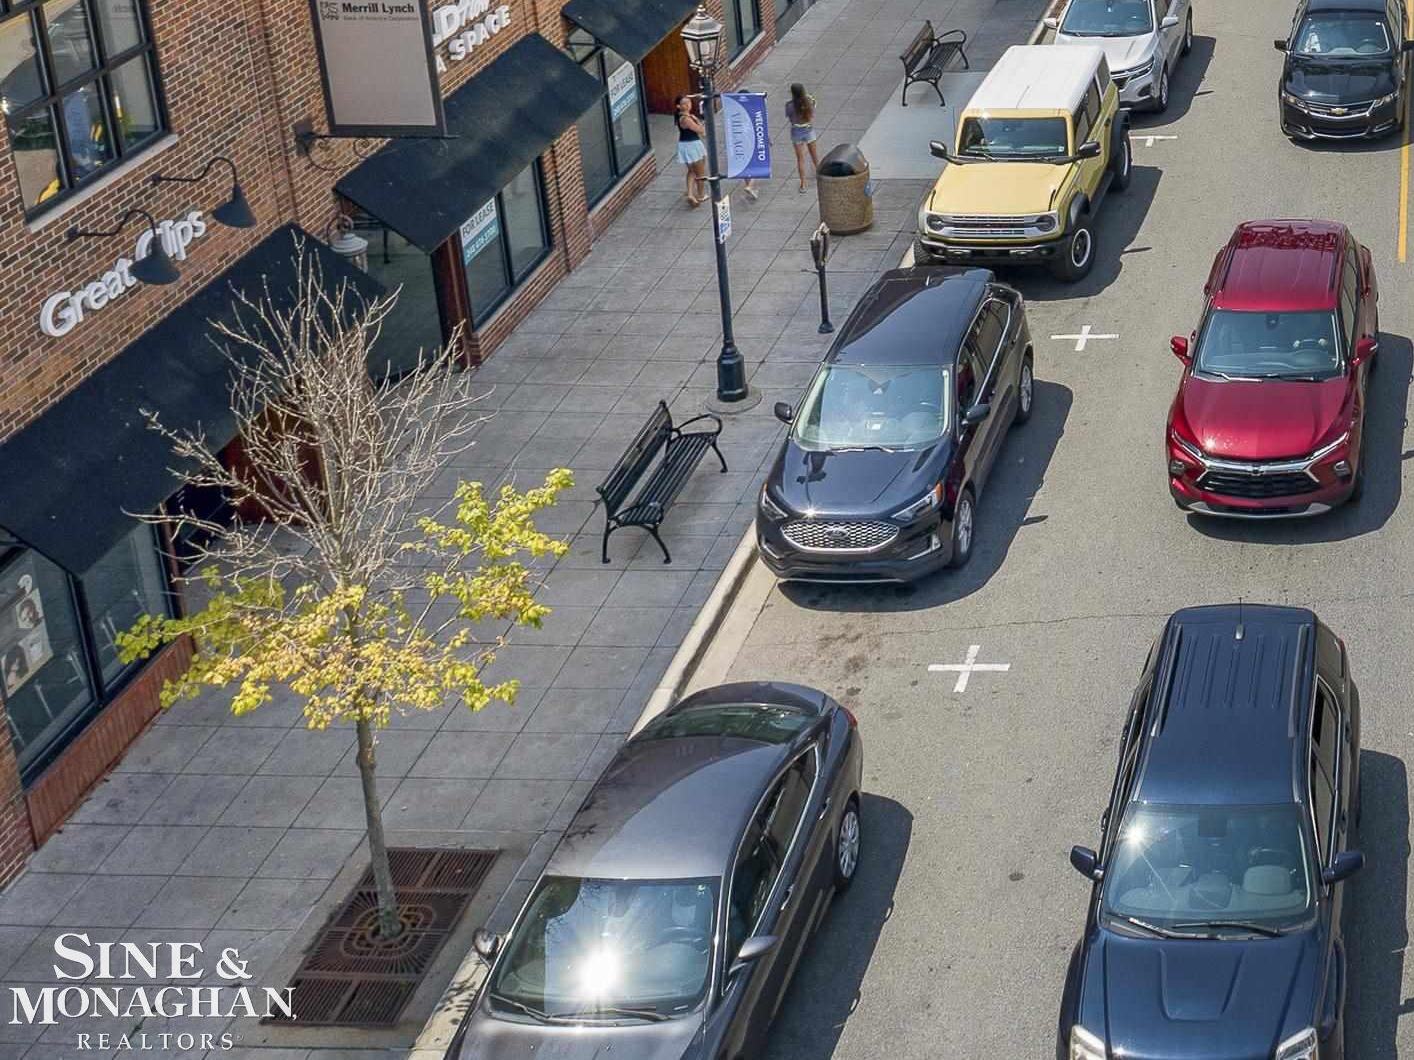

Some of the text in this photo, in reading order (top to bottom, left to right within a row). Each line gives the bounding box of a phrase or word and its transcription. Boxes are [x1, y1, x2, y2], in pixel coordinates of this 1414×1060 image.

[342, 3, 415, 16] Merrill Lynch
[448, 4, 512, 61] SPACE
[731, 112, 745, 161] VILLAGE
[754, 110, 767, 161] WELCOME TO
[39, 257, 137, 337] Great
